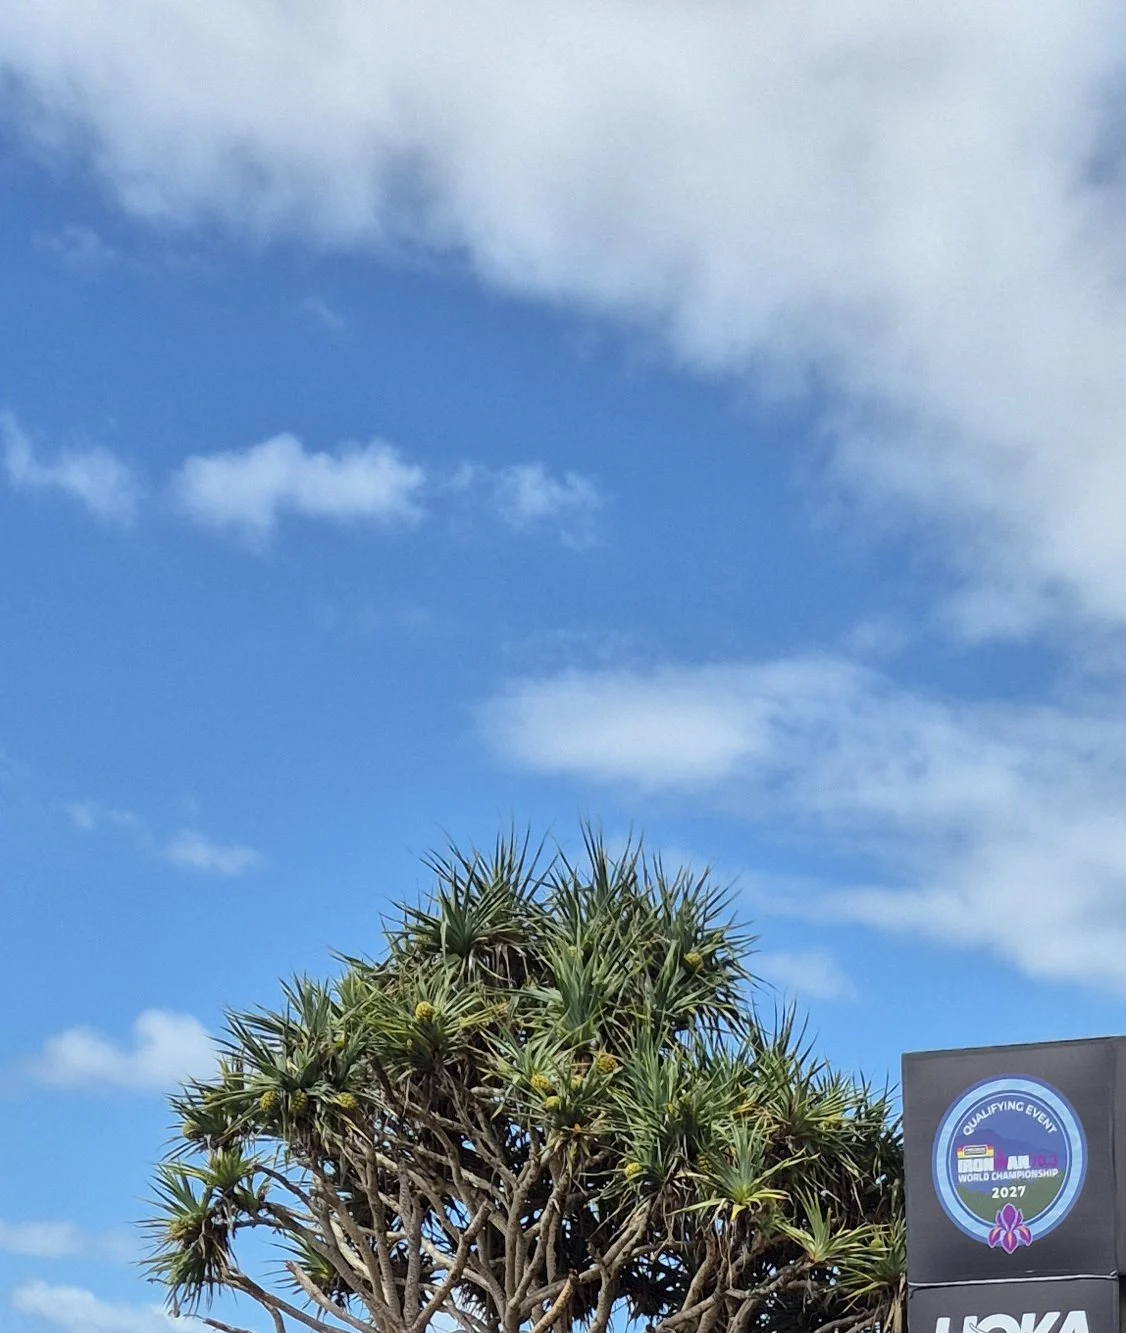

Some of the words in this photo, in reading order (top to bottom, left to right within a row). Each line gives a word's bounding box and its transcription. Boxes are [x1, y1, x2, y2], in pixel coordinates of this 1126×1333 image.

[962, 1100, 1024, 1136] QUALIFYING
[1025, 1105, 1058, 1134] EVENT
[957, 1172, 990, 1183] WORLD
[991, 1168, 1059, 1181] CHAMPIONSHIP
[991, 1185, 1026, 1199] 2027
